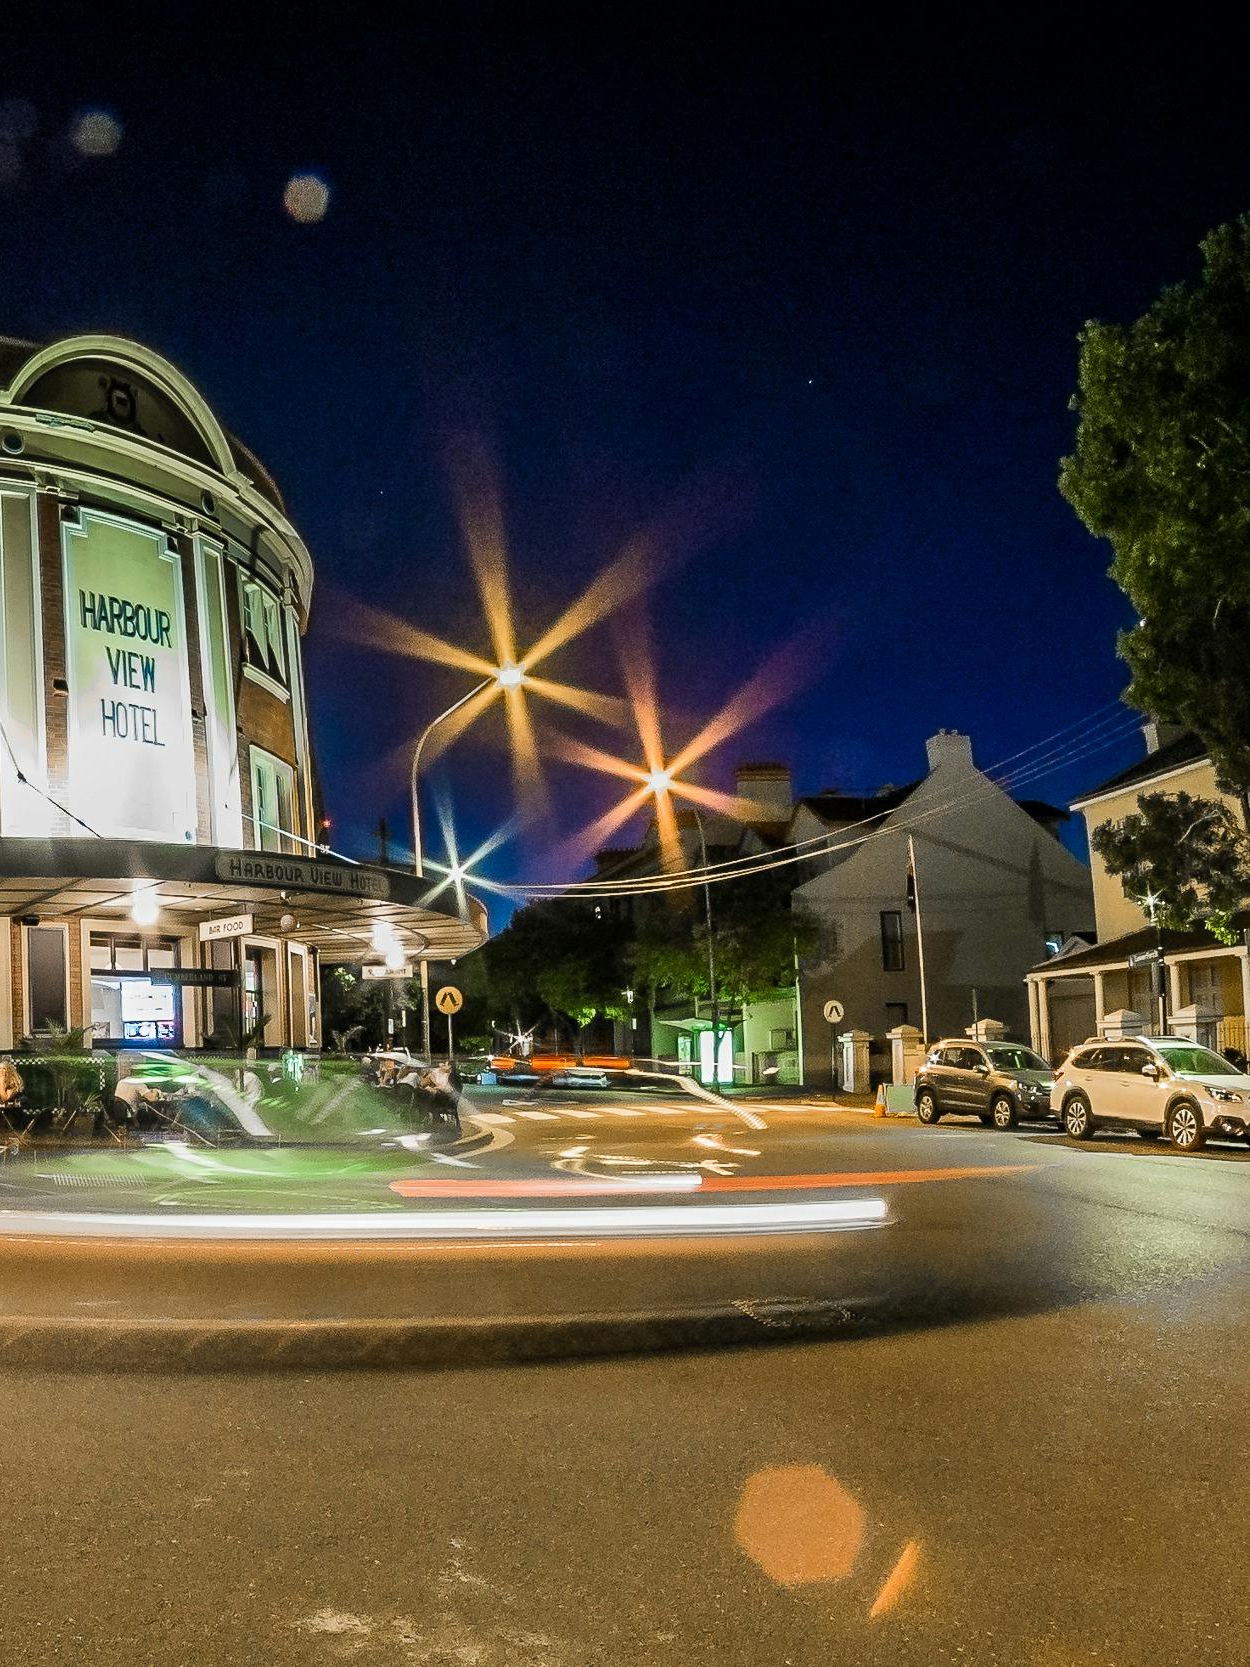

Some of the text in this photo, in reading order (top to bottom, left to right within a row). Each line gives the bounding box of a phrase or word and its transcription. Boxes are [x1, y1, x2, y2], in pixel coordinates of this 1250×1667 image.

[78, 588, 172, 648] HARBOUR
[104, 646, 156, 693] VIEW
[100, 698, 166, 747] HOTEL
[229, 858, 387, 893] HARBOUR VIEW HOTEL
[208, 921, 244, 934] BAR FOOD
